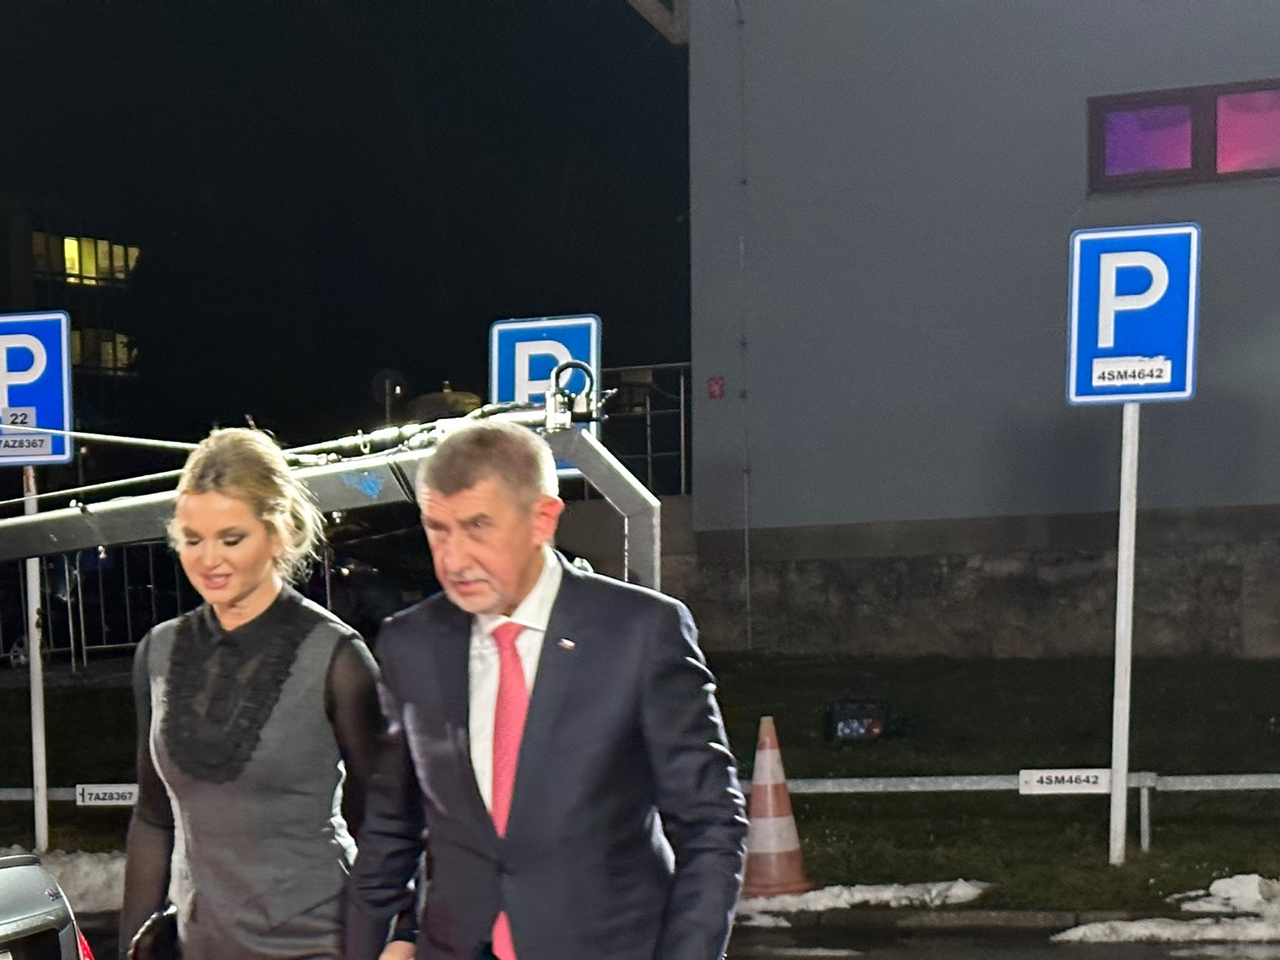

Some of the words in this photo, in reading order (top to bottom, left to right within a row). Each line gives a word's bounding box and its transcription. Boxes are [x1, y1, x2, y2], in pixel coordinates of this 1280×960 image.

[1097, 251, 1169, 348] P
[515, 340, 573, 403] P
[1097, 368, 1164, 381] 4SM4642
[10, 413, 28, 424] 22
[1036, 775, 1099, 785] 4SM4642
[87, 792, 133, 801] 7AZ8367
